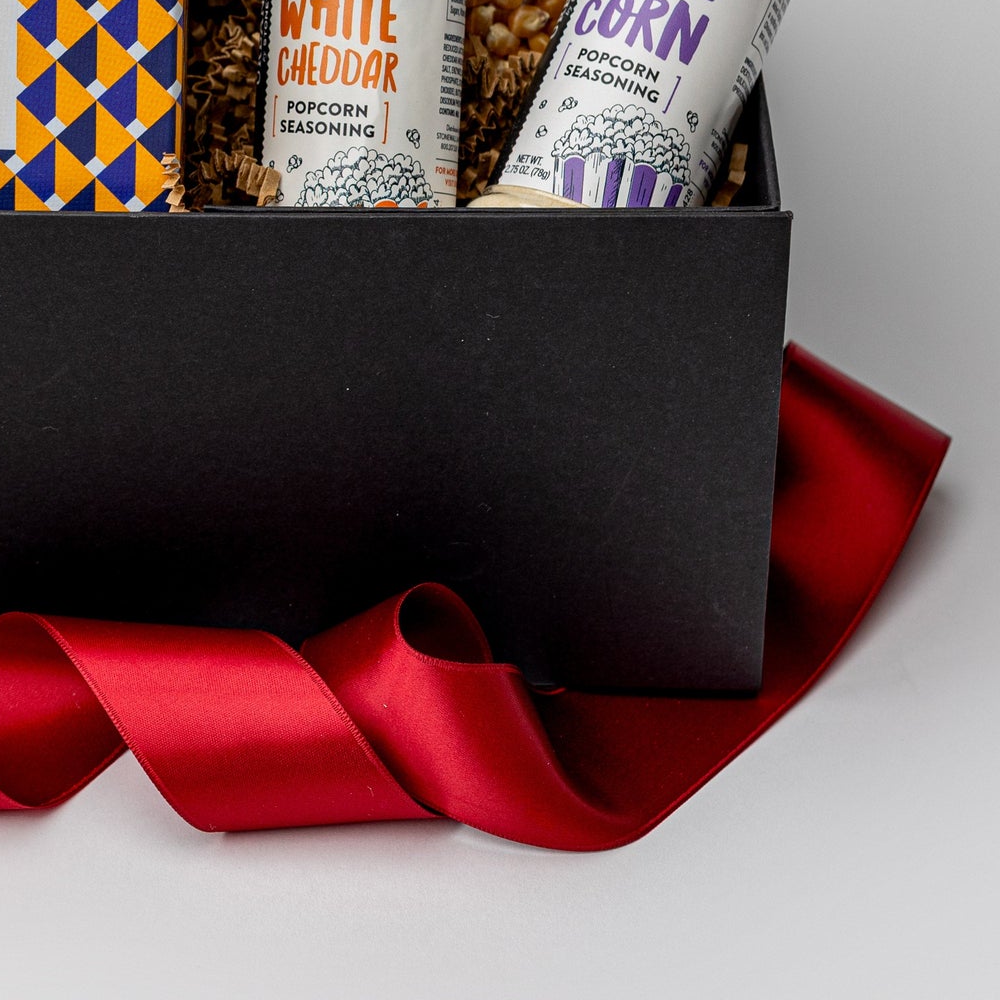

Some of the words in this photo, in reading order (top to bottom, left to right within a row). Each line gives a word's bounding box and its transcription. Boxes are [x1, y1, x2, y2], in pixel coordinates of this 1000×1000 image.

[277, 41, 399, 93] CHEDDAR
[577, 47, 661, 84] POPCORN
[563, 64, 661, 104] SEASONING
[286, 100, 369, 118] POPCORN
[280, 119, 376, 139] SEASONING
[516, 154, 531, 164] NET
[530, 167, 551, 181] (78g)
